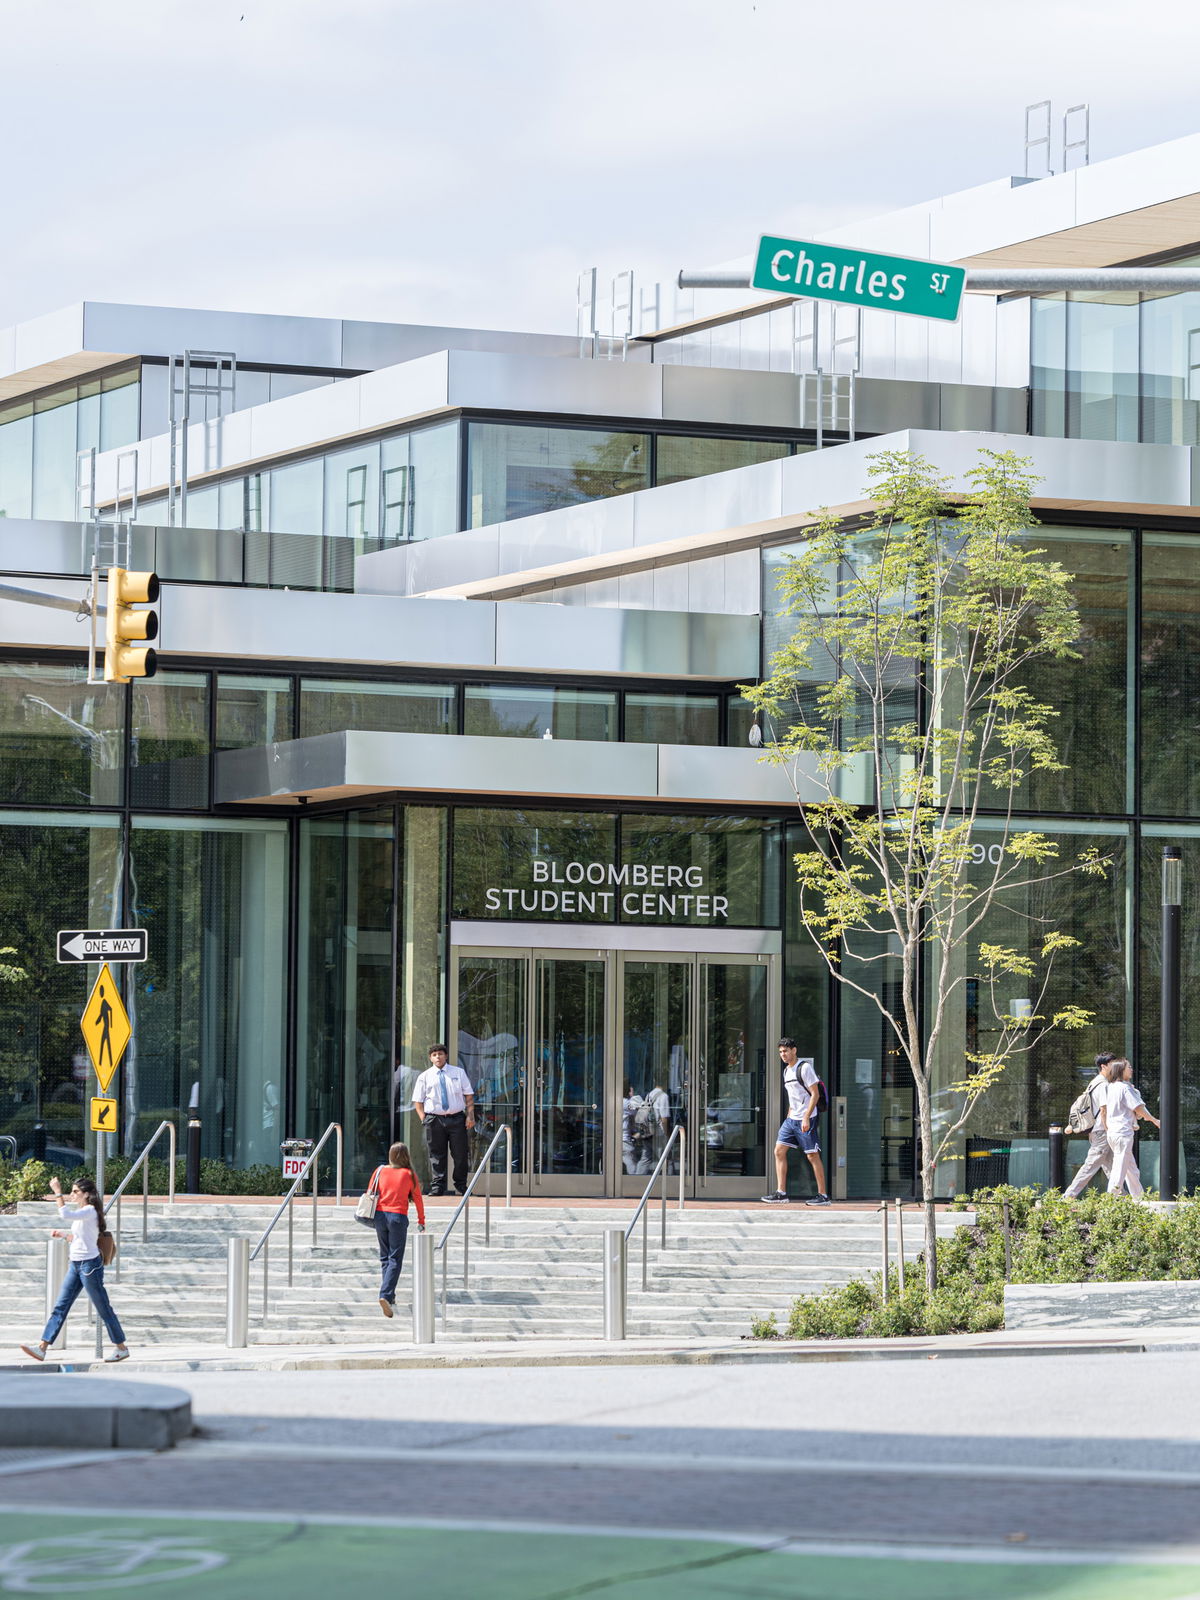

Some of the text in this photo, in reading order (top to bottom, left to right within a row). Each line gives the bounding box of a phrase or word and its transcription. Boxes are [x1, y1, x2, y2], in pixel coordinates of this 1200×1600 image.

[771, 249, 950, 301] Charles ST
[533, 860, 703, 888] BLOOMBERG
[485, 888, 729, 918] STUDENT CENTER
[85, 940, 136, 952] ONE WAY
